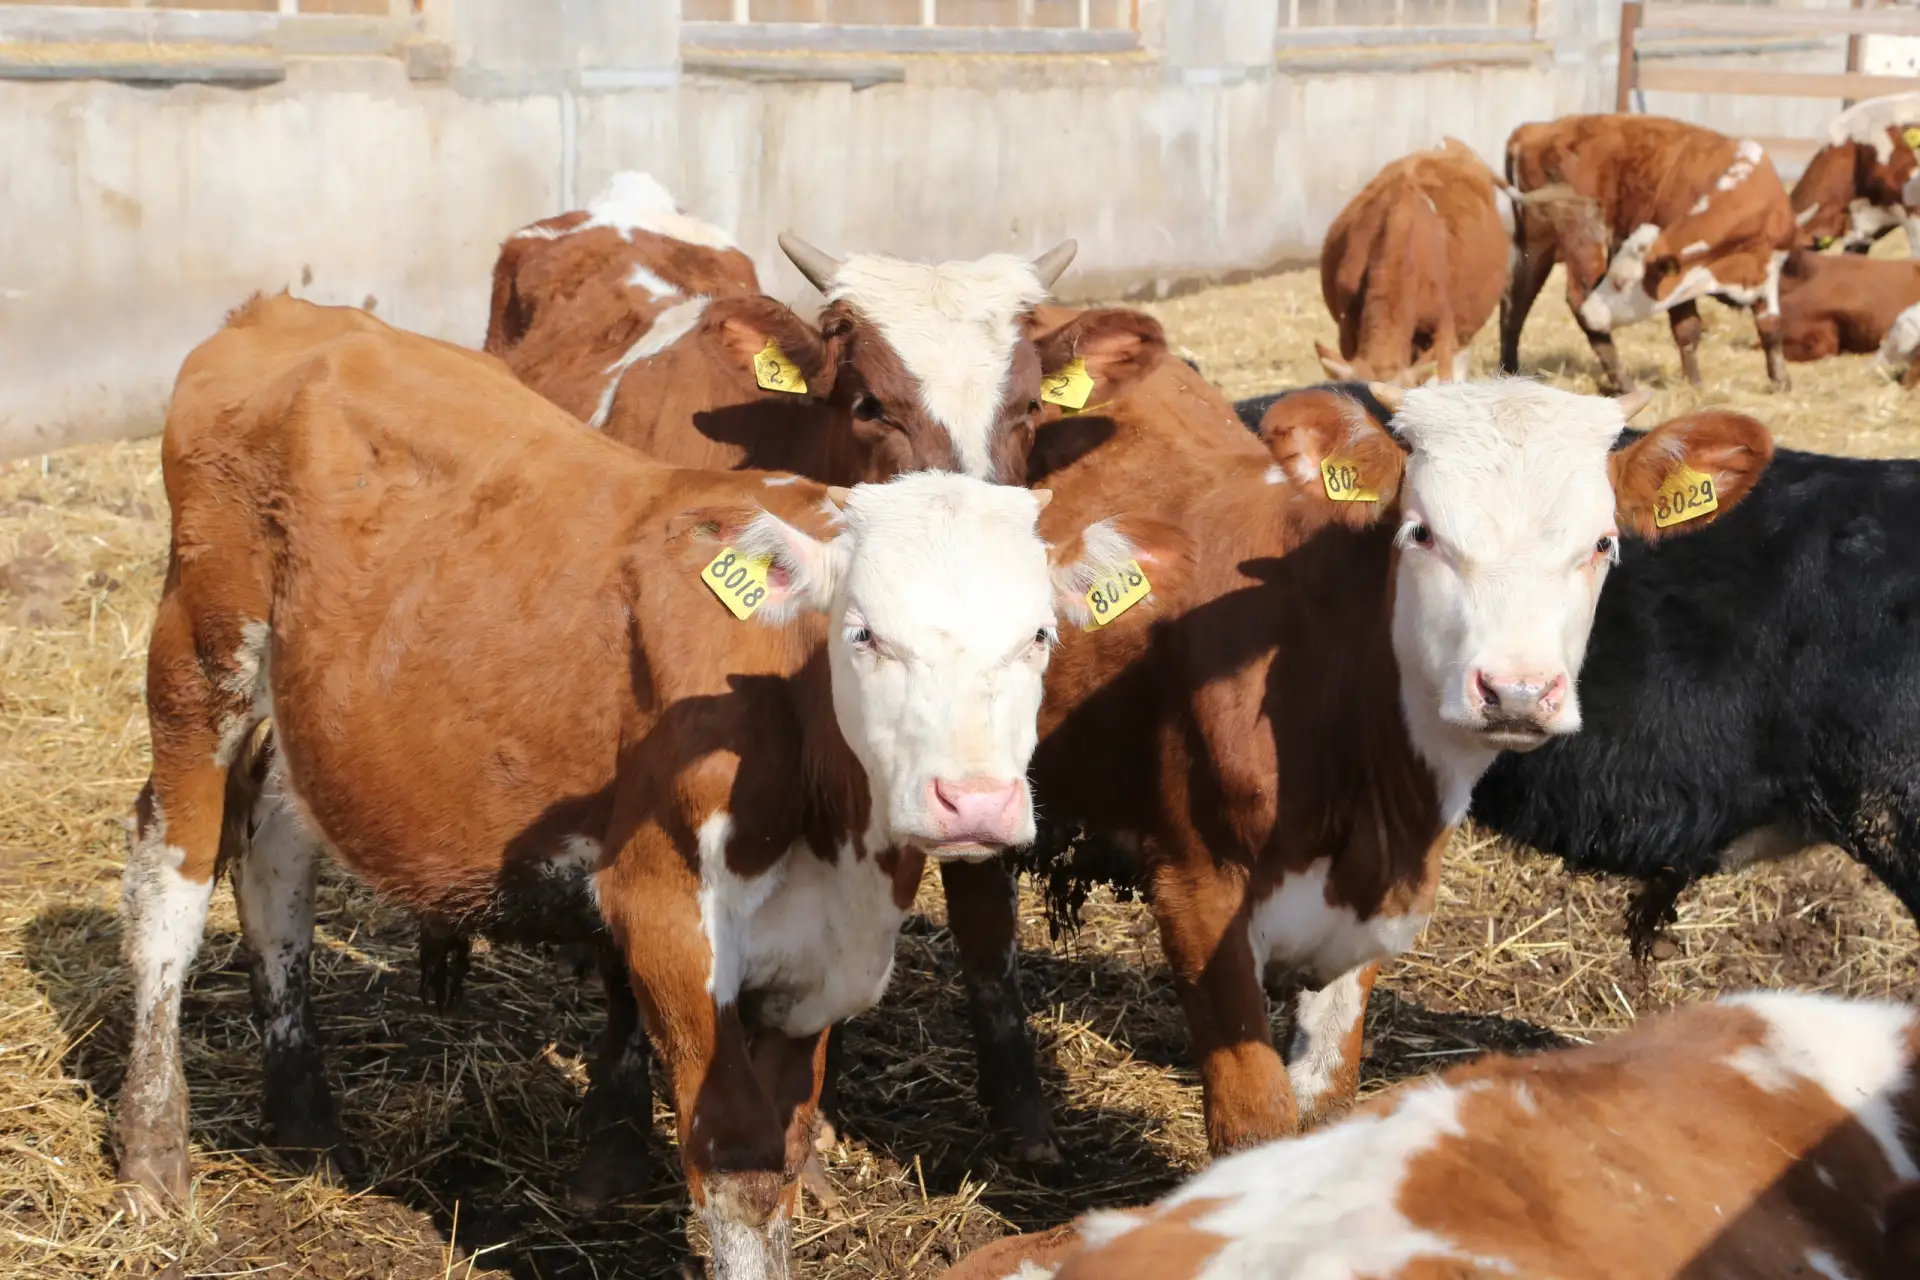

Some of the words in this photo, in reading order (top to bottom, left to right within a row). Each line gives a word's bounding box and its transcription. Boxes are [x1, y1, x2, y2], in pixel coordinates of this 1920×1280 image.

[769, 360, 784, 384] 2
[1050, 376, 1070, 396] 2
[1657, 480, 1714, 520] 8029
[711, 553, 765, 608] 8018
[1091, 566, 1143, 614] 8018
